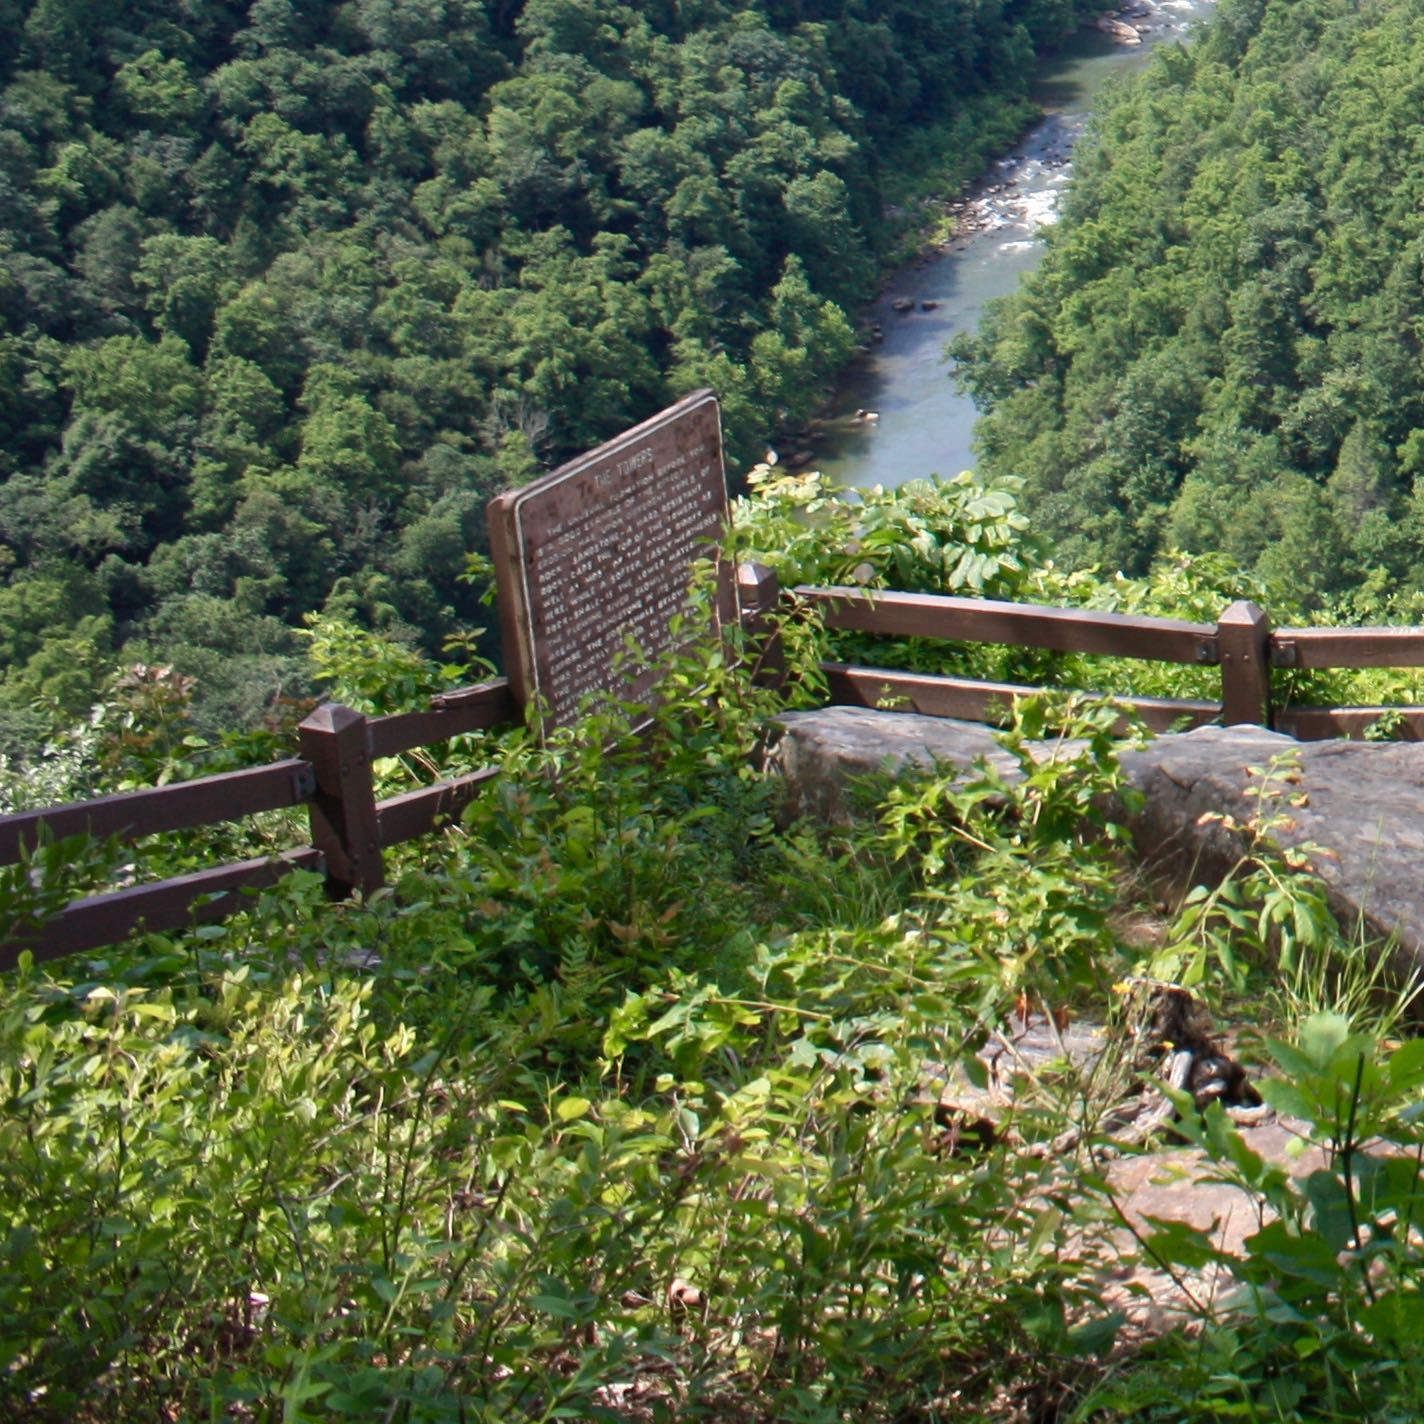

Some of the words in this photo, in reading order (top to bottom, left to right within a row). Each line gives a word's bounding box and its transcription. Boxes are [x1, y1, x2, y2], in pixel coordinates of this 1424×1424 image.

[593, 467, 611, 491] THE
[616, 446, 652, 479] TOWERS
[596, 548, 612, 564] THE
[617, 536, 632, 553] TOP
[648, 519, 662, 534] THE
[667, 498, 698, 523] TOWERS
[618, 577, 632, 593] THE
[586, 636, 602, 653] THE
